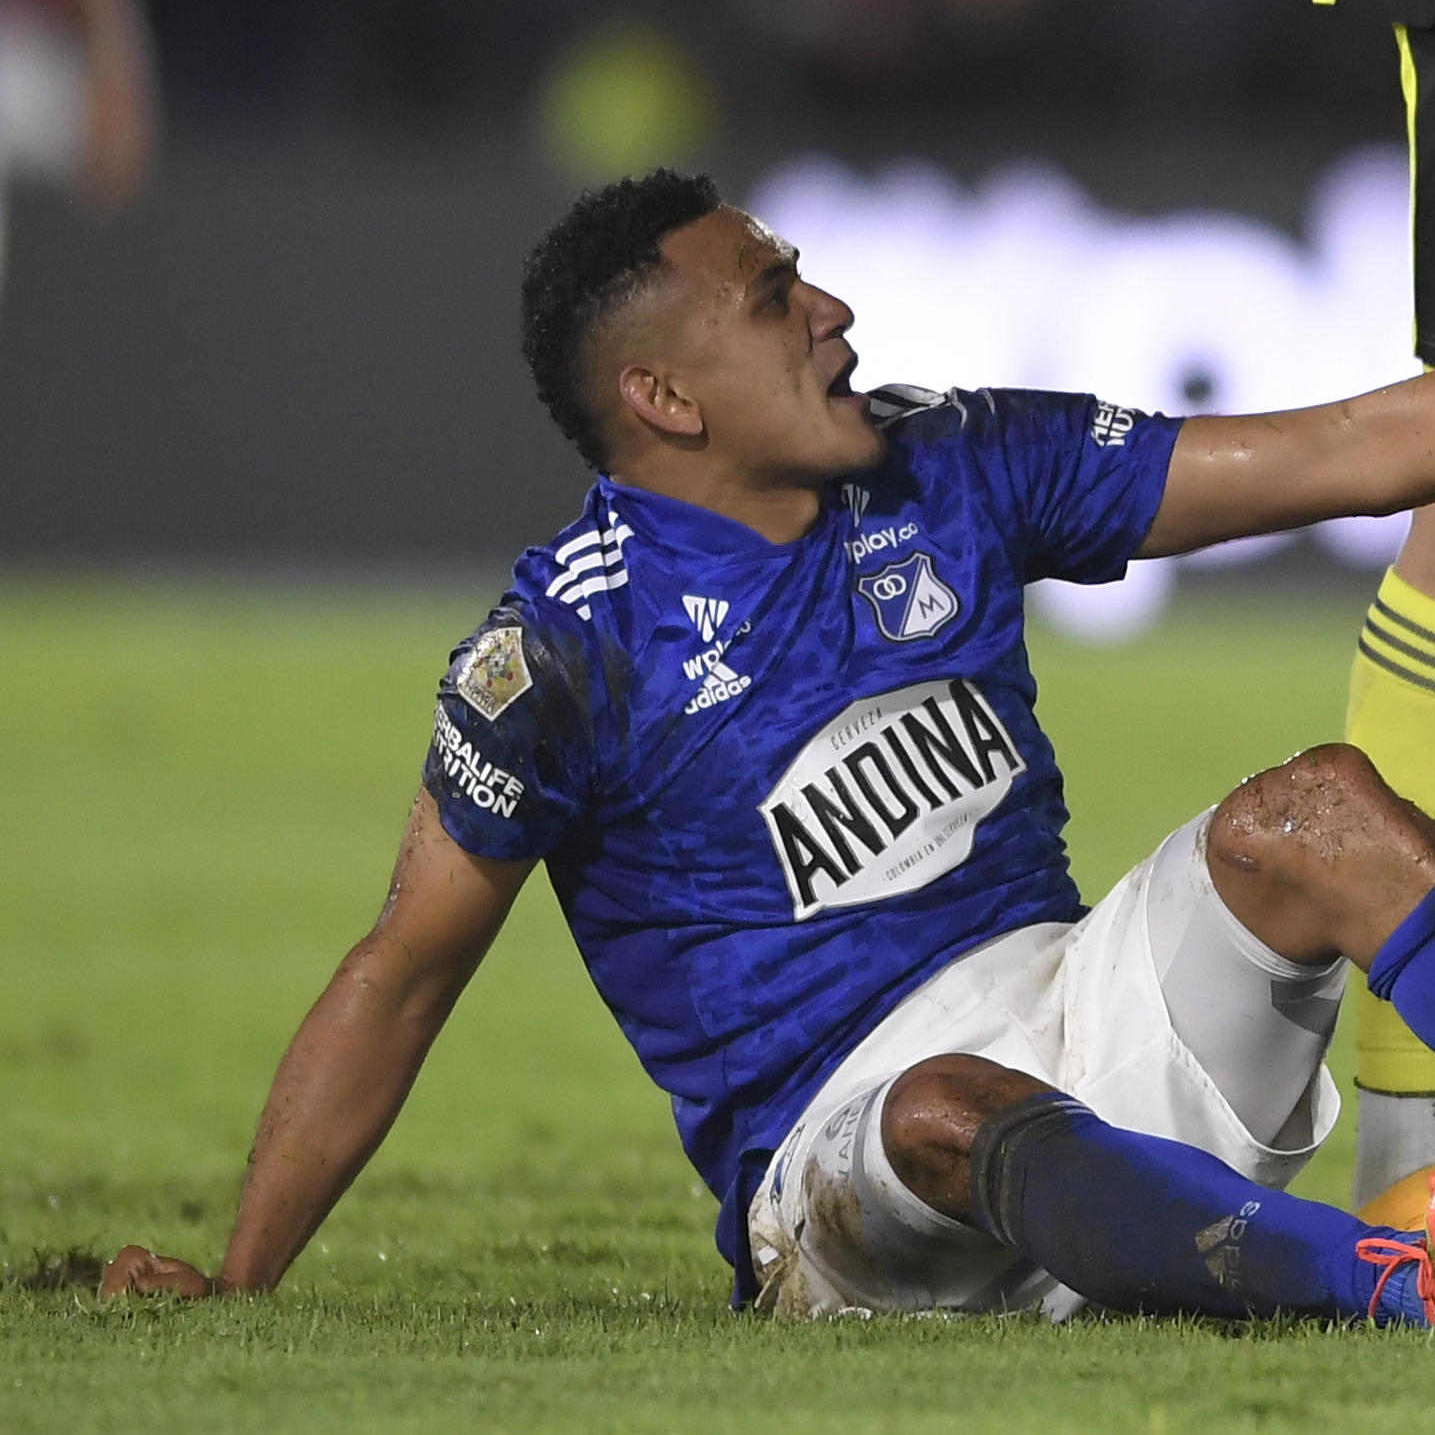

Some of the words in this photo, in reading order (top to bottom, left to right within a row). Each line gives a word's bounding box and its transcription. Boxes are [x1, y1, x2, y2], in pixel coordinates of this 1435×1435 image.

[830, 707, 883, 751] CERVEZA
[434, 729, 518, 818] TRITION
[770, 679, 1020, 909] ANDINA
[886, 850, 923, 881] COLOMBIA
